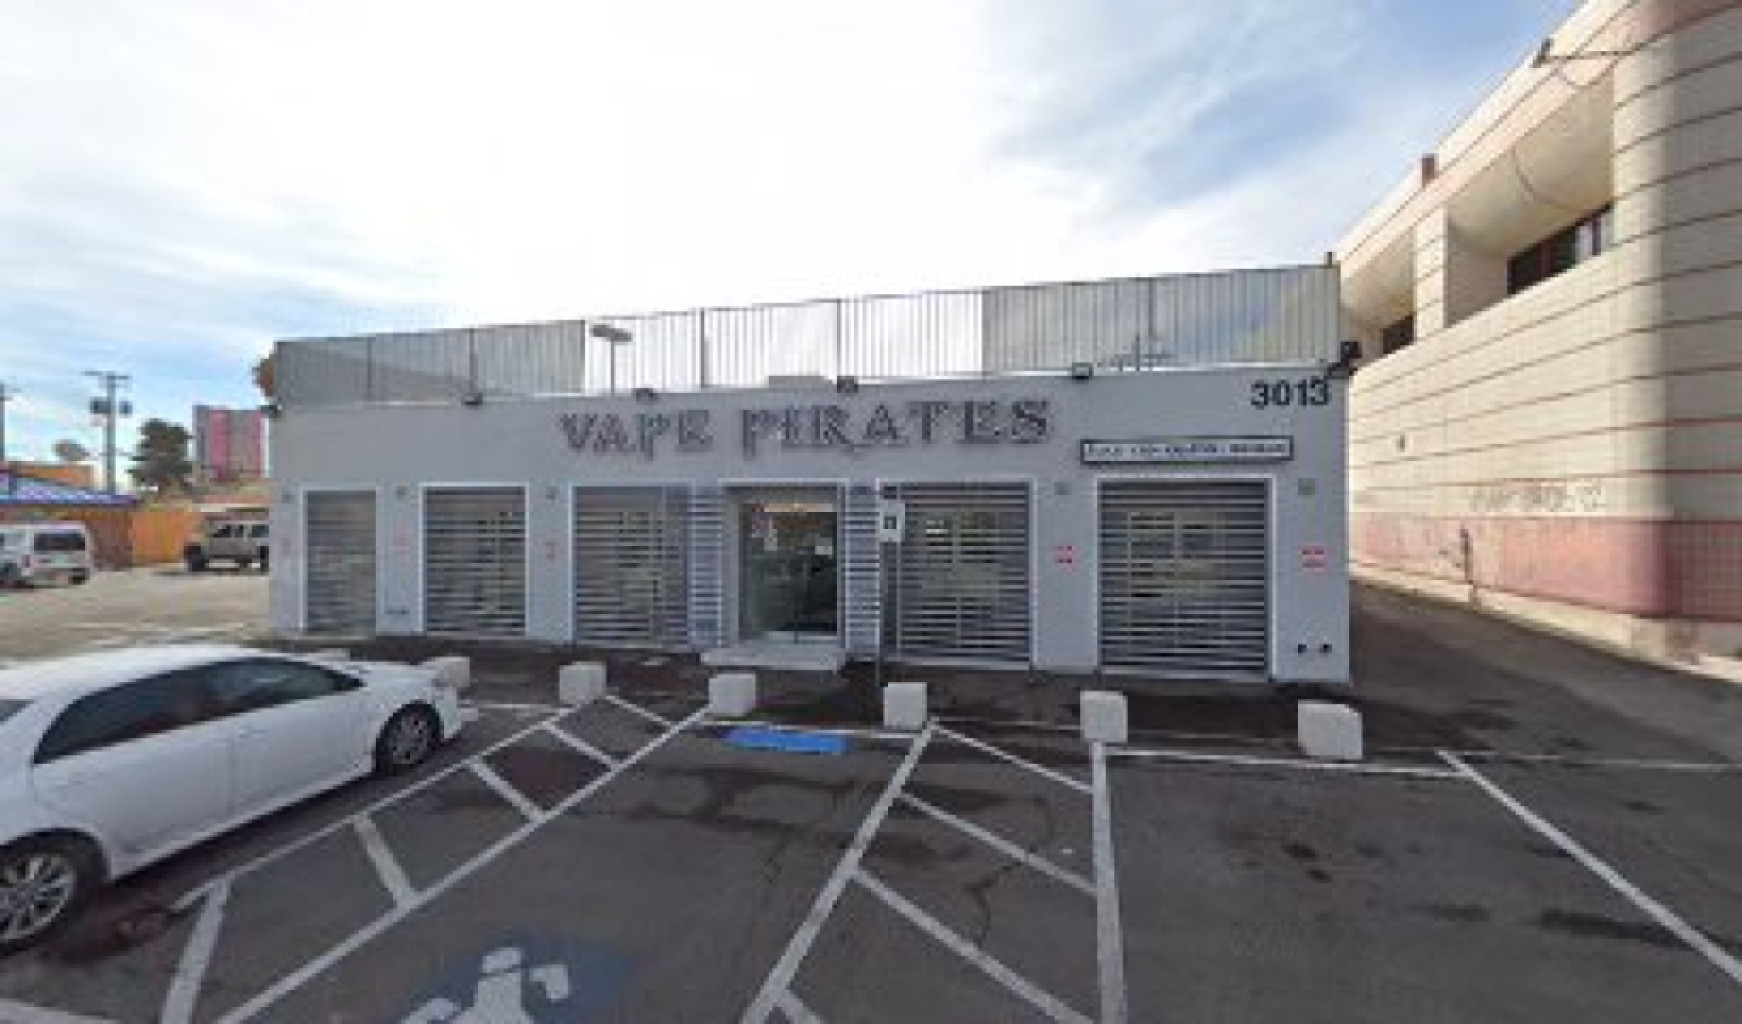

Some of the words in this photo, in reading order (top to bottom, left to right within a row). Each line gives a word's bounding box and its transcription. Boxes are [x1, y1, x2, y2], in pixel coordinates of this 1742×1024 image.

[1250, 379, 1330, 408] 3013
[559, 408, 712, 460] VAPE
[741, 399, 1052, 460] PIRATES
